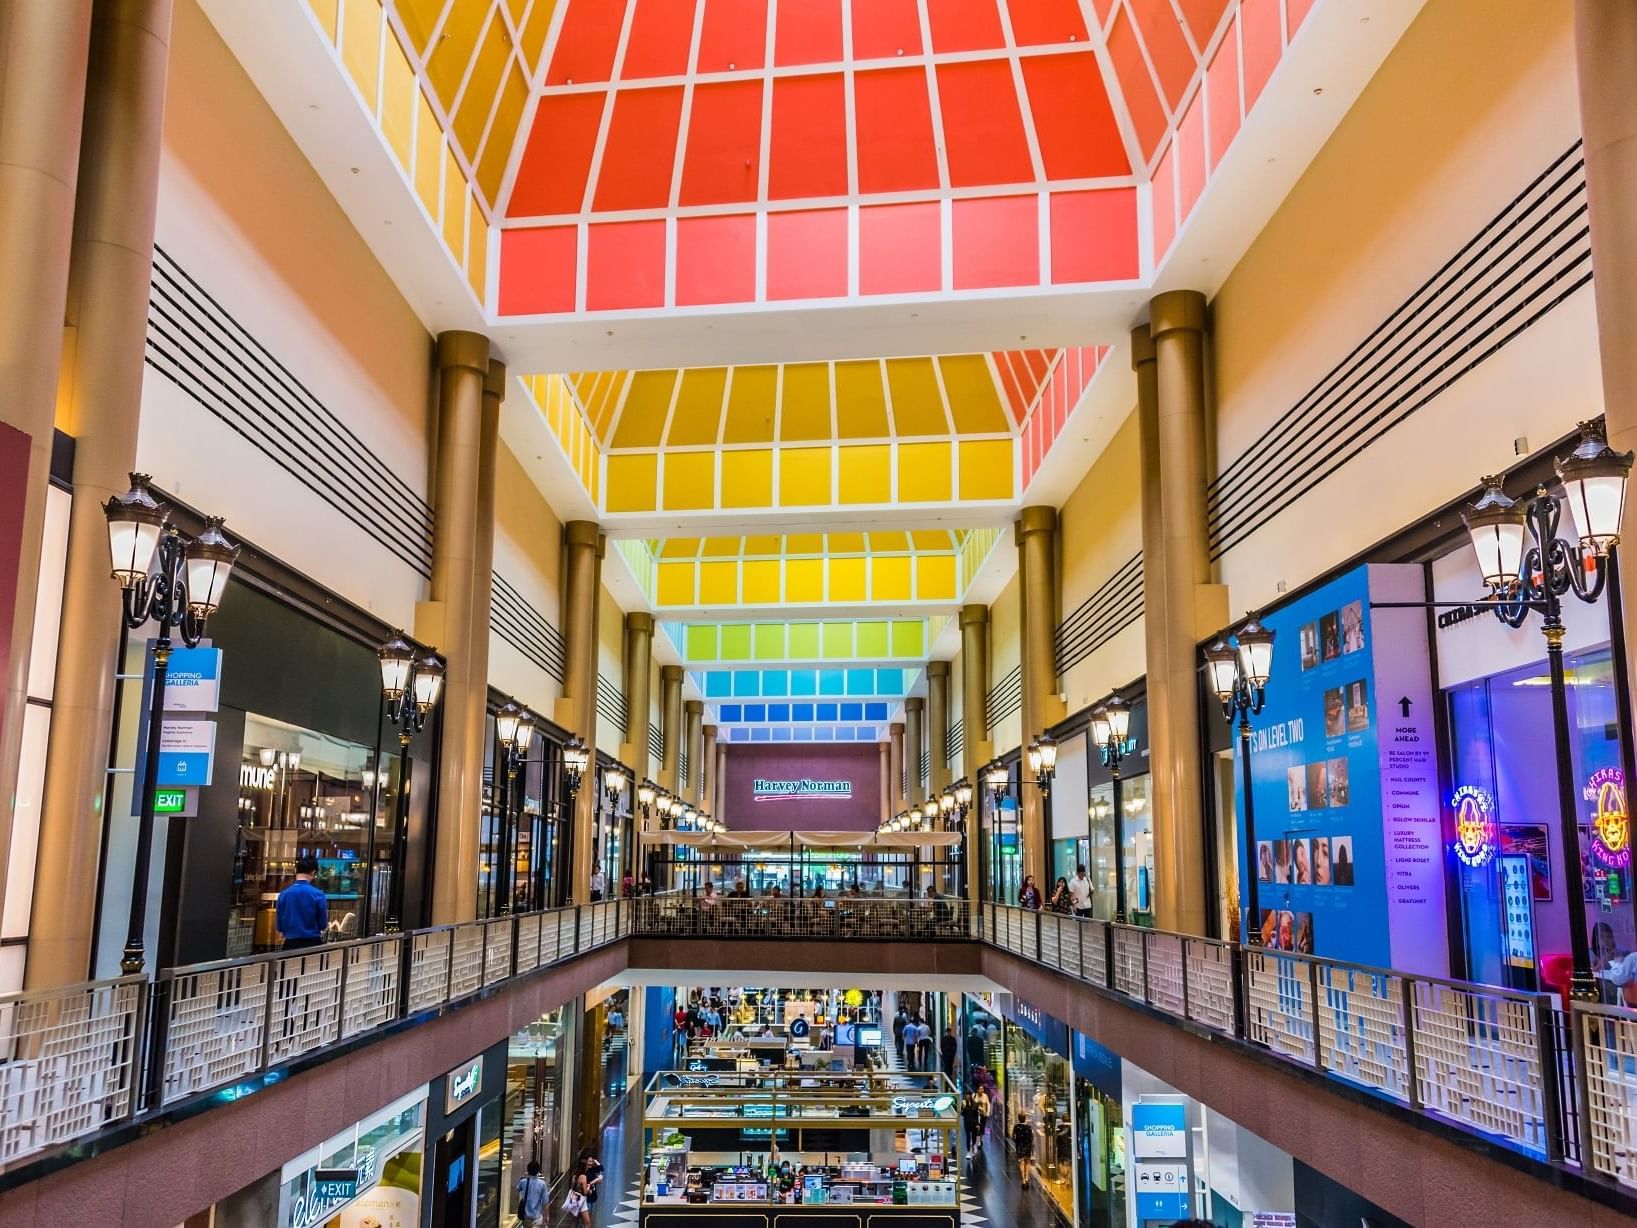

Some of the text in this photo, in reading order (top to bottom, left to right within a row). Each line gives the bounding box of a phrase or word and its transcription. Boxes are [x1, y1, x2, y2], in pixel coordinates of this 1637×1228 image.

[1268, 723, 1288, 749] LEVEL
[1288, 717, 1304, 744] TWO
[754, 780, 850, 794] Harvey Norman
[157, 794, 184, 807] EXIT
[1616, 846, 1631, 867] KO
[328, 1183, 352, 1196] EXIT
